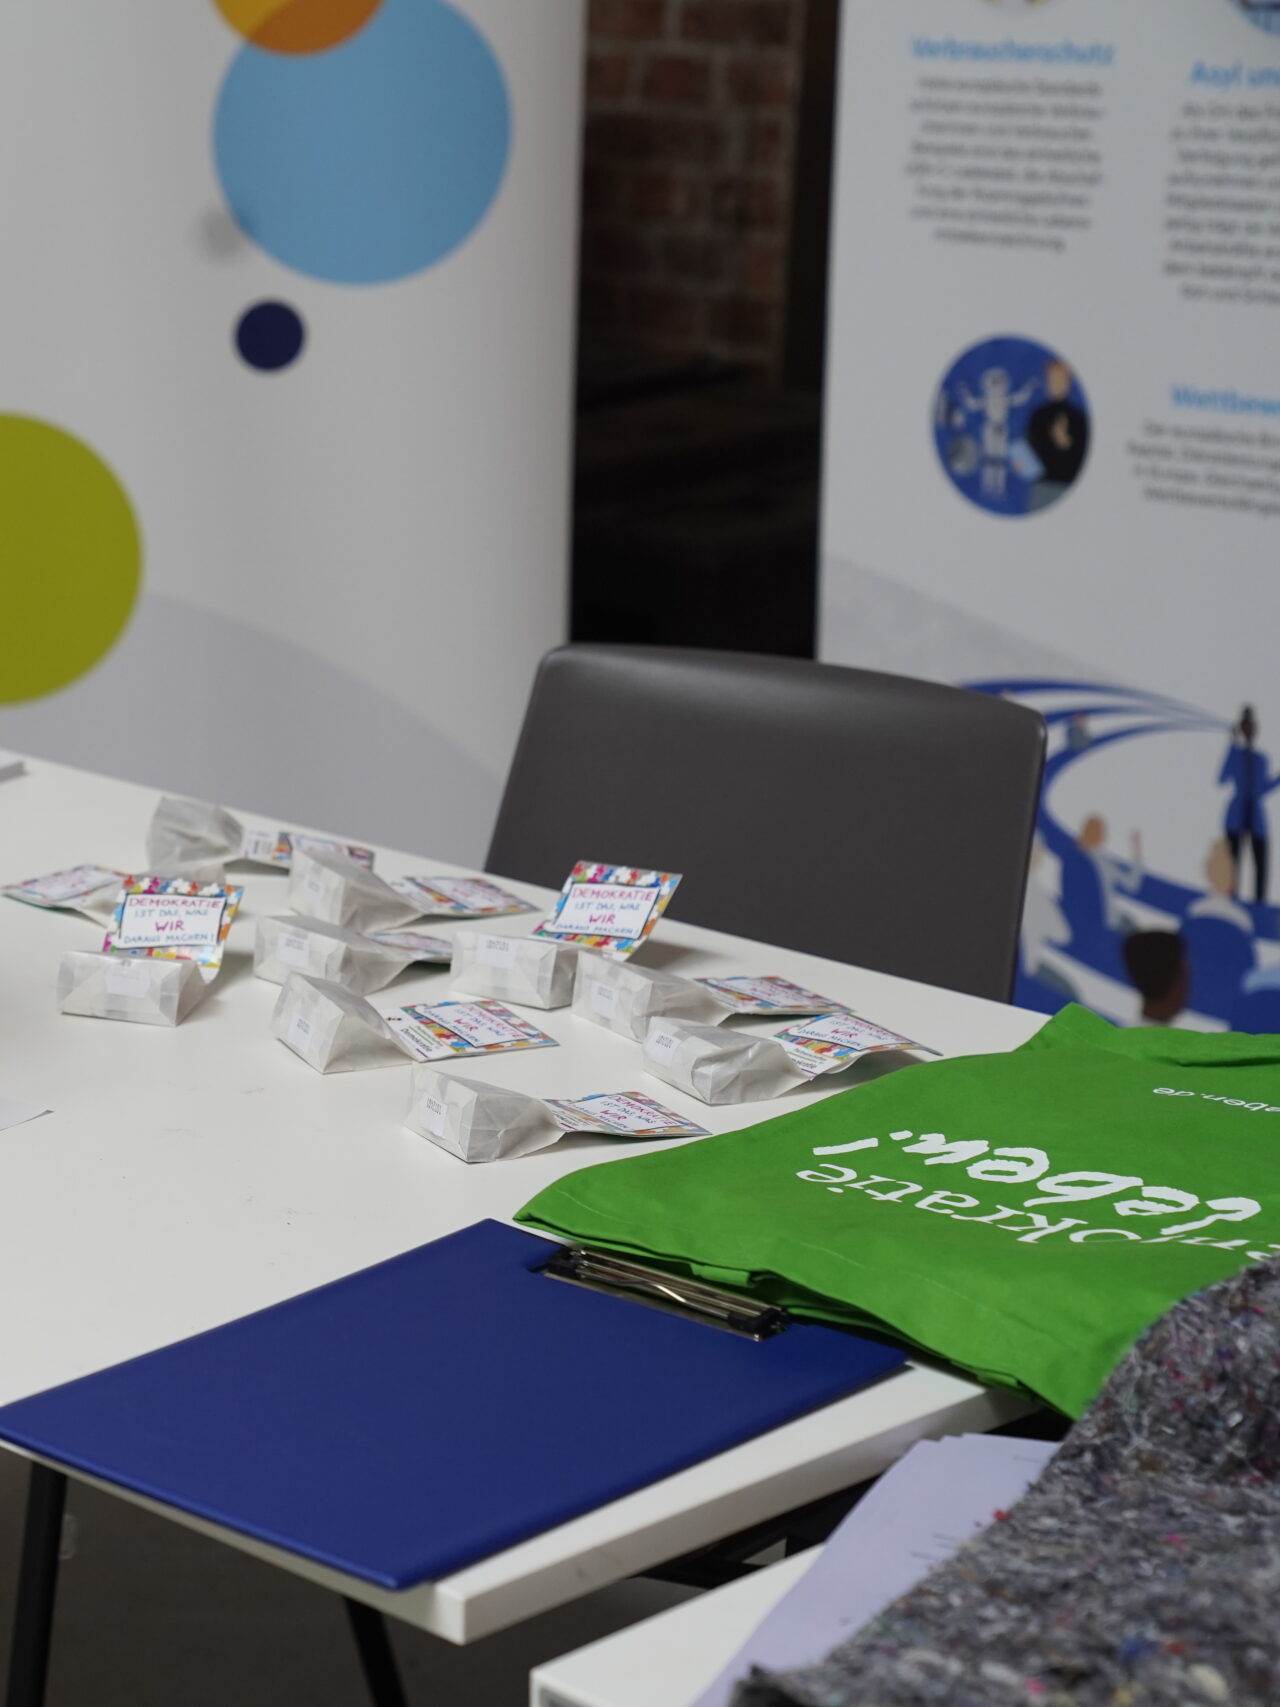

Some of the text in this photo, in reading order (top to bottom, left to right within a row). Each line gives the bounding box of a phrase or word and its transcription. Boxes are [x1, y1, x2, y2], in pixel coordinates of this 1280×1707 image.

[572, 887, 655, 901] DEMOKRATIE
[128, 898, 221, 908] DEMOKRATIE
[588, 914, 616, 924] WIR
[155, 920, 185, 932] WIR
[453, 1018, 479, 1032] WIR
[813, 1130, 1261, 1235] leben!
